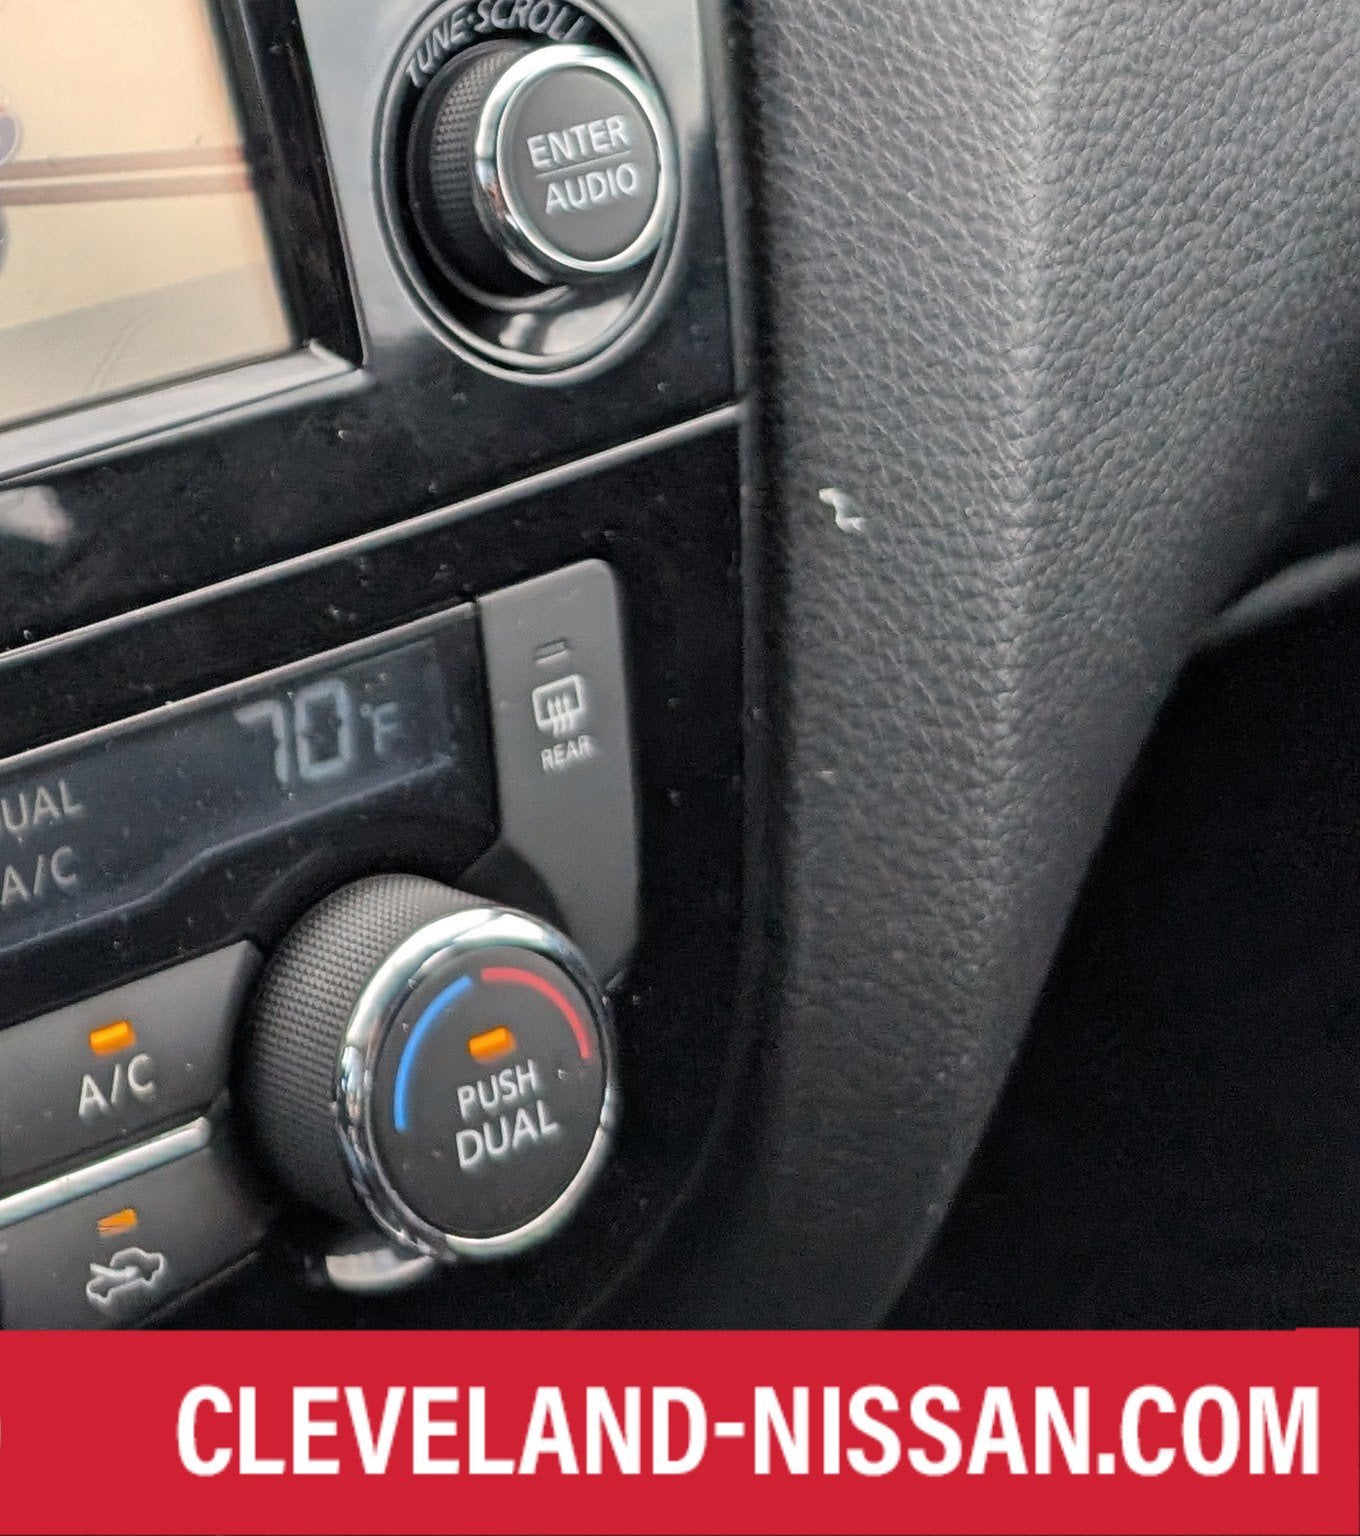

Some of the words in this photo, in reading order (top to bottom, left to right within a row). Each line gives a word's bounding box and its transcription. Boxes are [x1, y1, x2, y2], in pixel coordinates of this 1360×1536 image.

[527, 115, 631, 168] ENTER
[544, 166, 639, 215] AUDIO
[541, 735, 594, 770] REAR
[0, 845, 79, 908] A/C
[78, 1055, 155, 1119] A/C
[456, 1060, 539, 1121] PUSH
[454, 1103, 559, 1170] DUAL
